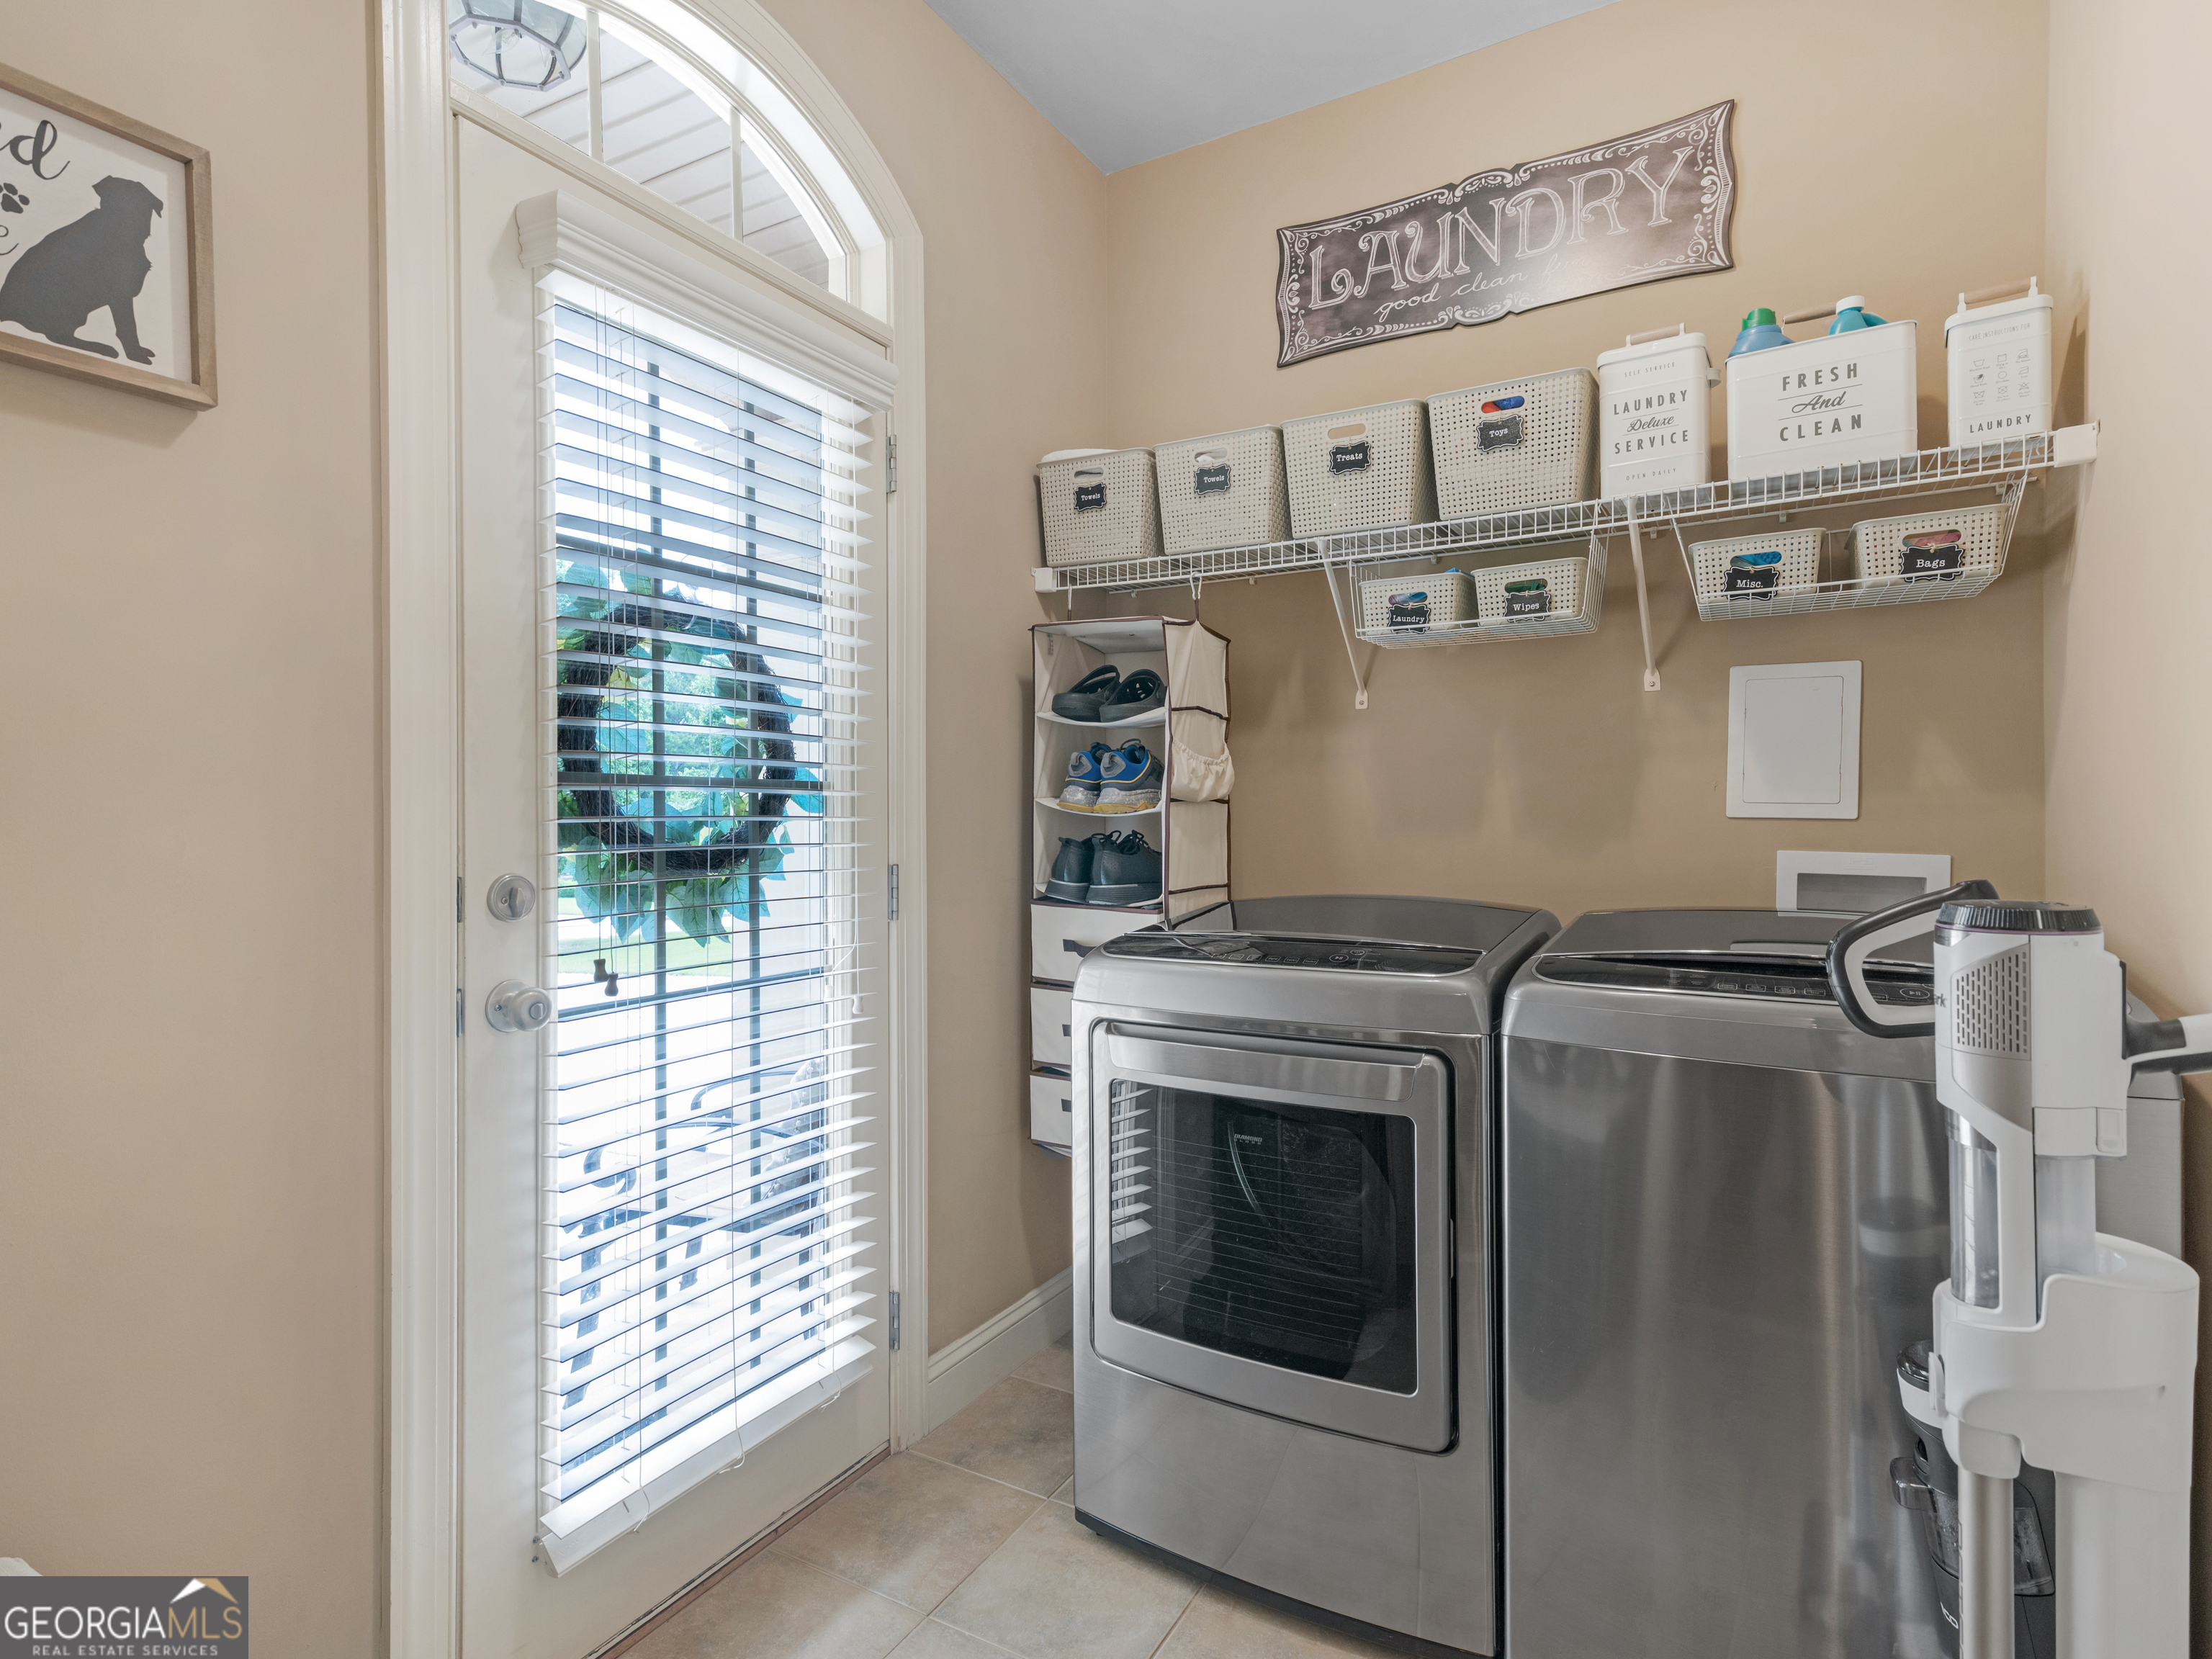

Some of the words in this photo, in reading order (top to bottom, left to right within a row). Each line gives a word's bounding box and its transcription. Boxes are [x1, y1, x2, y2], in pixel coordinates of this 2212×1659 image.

[1308, 146, 1694, 310] LAUNDRY
[1373, 282, 1442, 323] good
[1450, 271, 1529, 297] clean
[1539, 253, 1591, 289] fun
[1982, 325, 2019, 338] INSTRUCTIONS
[1645, 361, 1675, 373] SERVICE
[1782, 362, 1857, 392] FRESH
[1614, 390, 1687, 415] LAUNDRY
[1791, 390, 1846, 413] And
[1627, 416, 1675, 432] Deluxe
[1779, 414, 1861, 441] CLEAN
[1969, 414, 2031, 433] LAUNDRY
[1489, 427, 1509, 438] Toys
[1614, 430, 1688, 454] SERVICE
[1336, 452, 1363, 462] Treats
[1203, 475, 1225, 483] Towels
[1081, 493, 1101, 501] Towels
[1915, 559, 1946, 569] Bags
[1735, 579, 1763, 588] Misc.
[1513, 602, 1539, 612] Wipes
[1392, 614, 1426, 624] Laundry
[1234, 1133, 1263, 1143] DIAMOND
